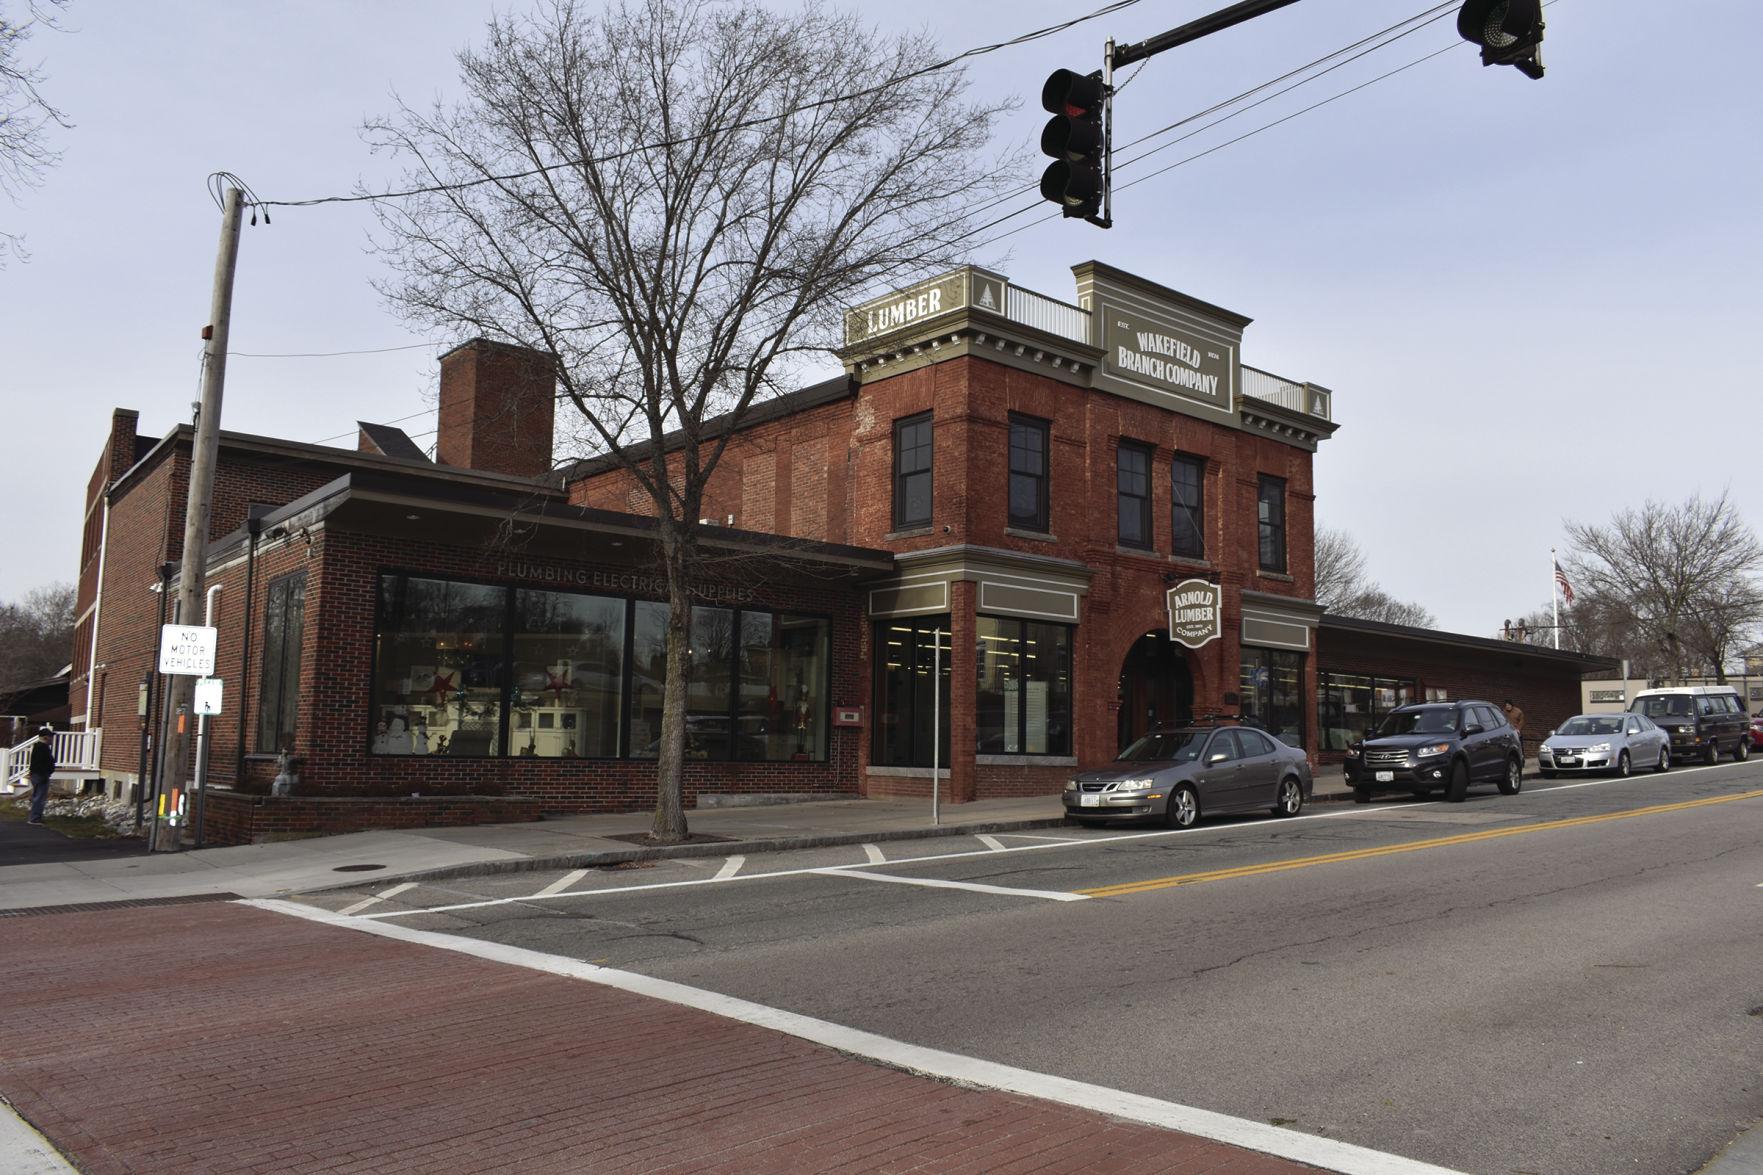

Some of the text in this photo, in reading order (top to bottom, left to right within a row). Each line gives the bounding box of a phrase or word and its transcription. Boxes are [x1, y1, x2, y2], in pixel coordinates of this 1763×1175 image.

[868, 288, 941, 334] LUMBER
[1136, 331, 1201, 369] WAKEFIELD
[1118, 345, 1218, 396] BRANCH COMPANY
[497, 560, 587, 584] PLUMBING
[593, 571, 678, 596] ELECTRIC
[1174, 591, 1213, 609] ARNOLD
[1175, 608, 1213, 623] LUMBER
[181, 632, 198, 642] NO
[1176, 624, 1212, 637] COMPANY
[171, 645, 205, 656] MOTOR
[164, 657, 210, 669] VEHICLES
